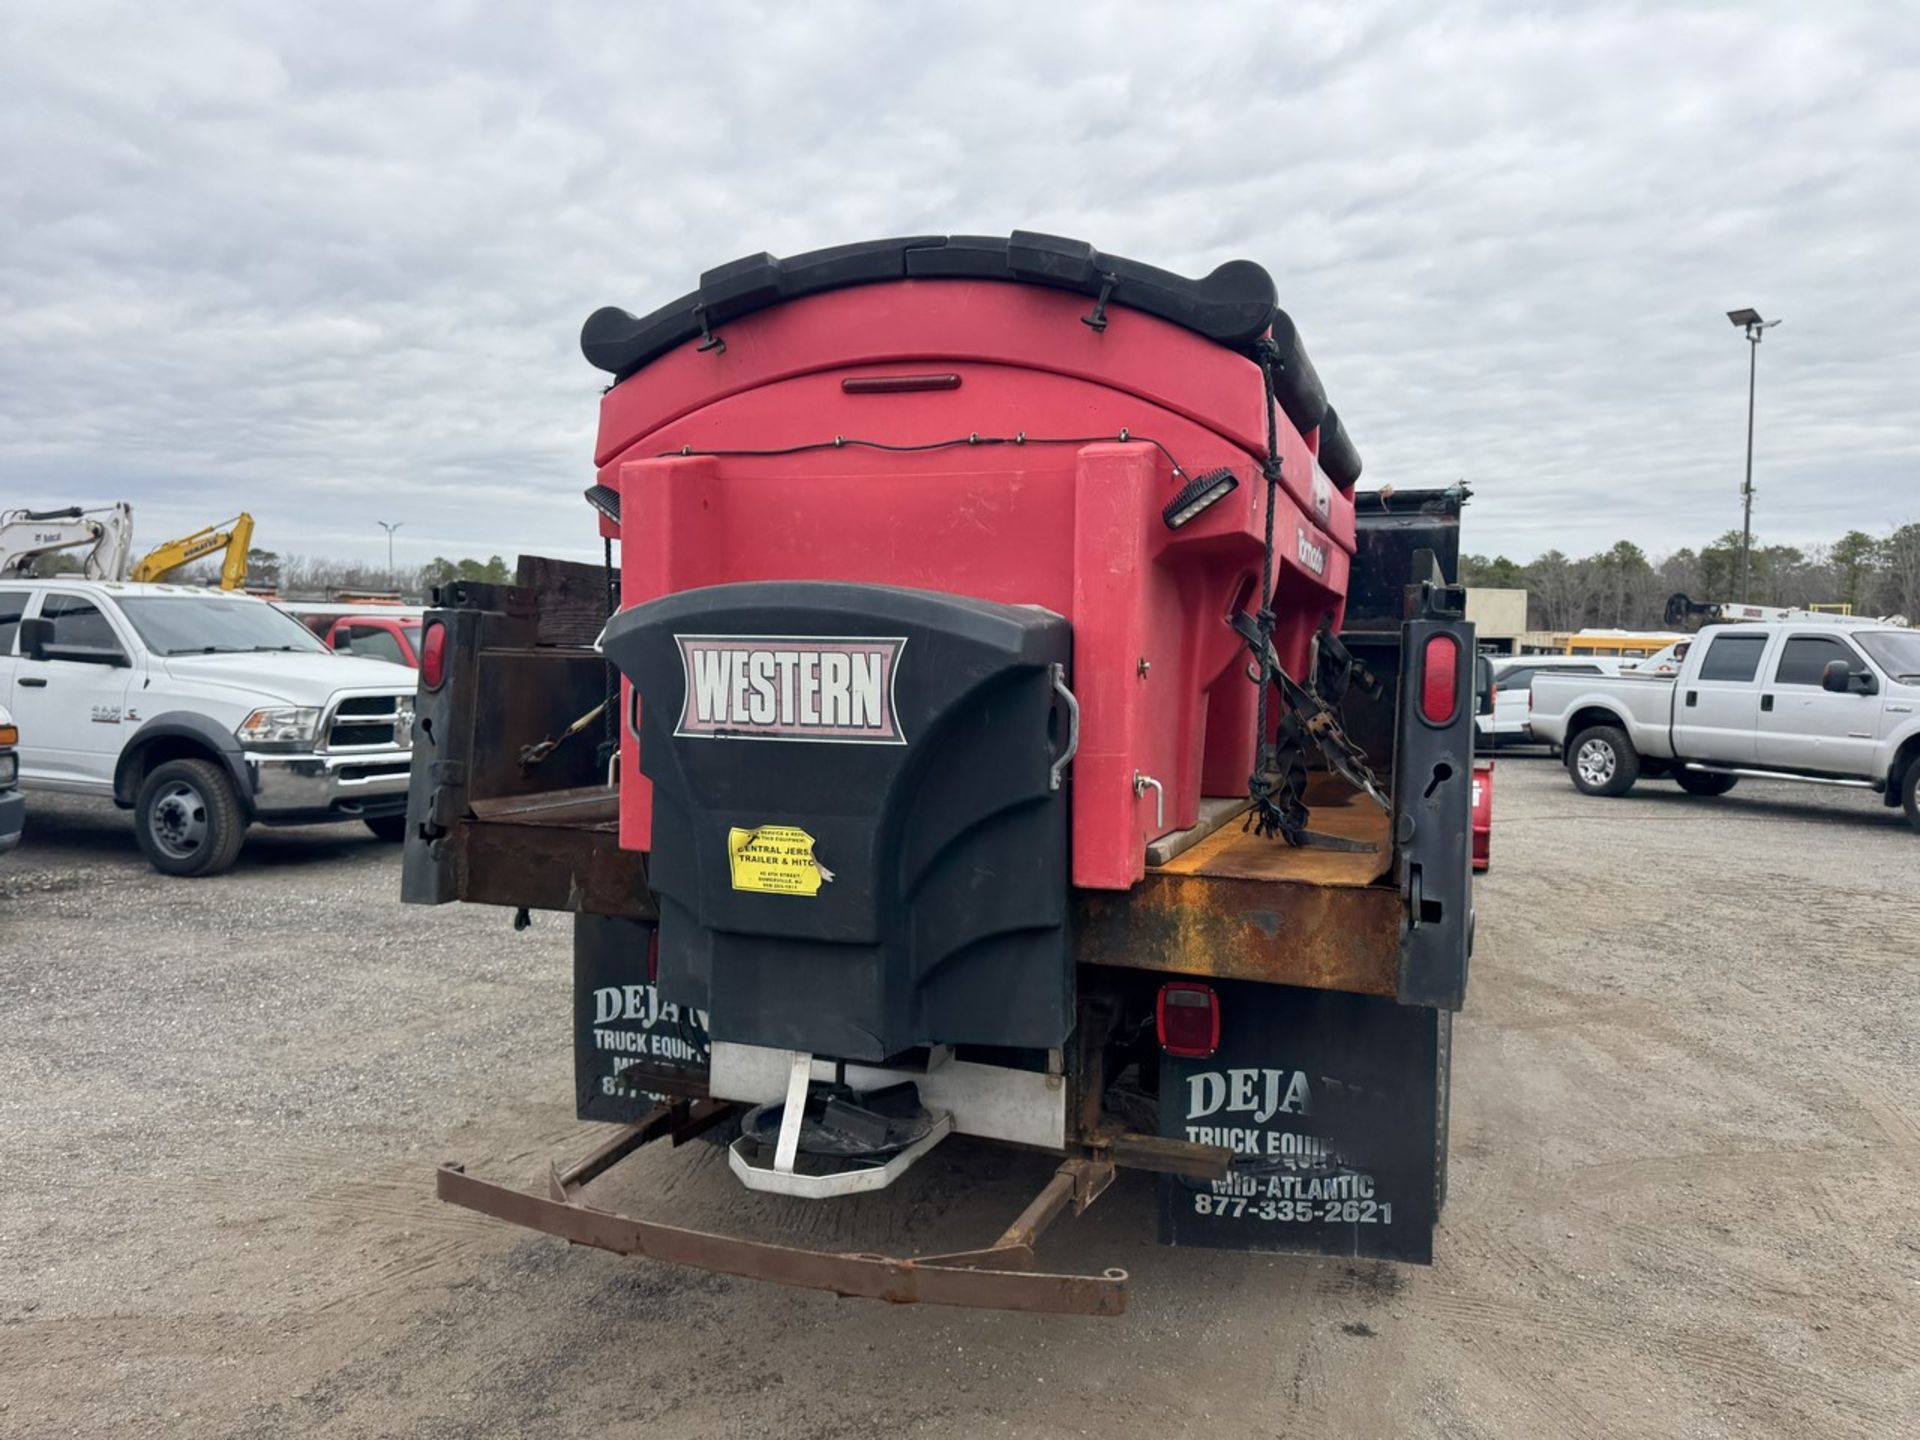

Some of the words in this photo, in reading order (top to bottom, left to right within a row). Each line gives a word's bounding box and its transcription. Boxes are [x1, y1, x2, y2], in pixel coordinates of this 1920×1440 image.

[692, 649, 883, 728] WESTERN
[738, 845, 782, 855] CENTRAL
[784, 847, 811, 856] JERS
[738, 855, 779, 865] TRAILER
[593, 1029, 647, 1053] TRUCK
[1186, 1069, 1318, 1124] DEJA
[1185, 1126, 1260, 1154] TRUCK
[1212, 1172, 1375, 1200] MID-ATLANTIC
[1195, 1194, 1392, 1224] 877-335-2621
